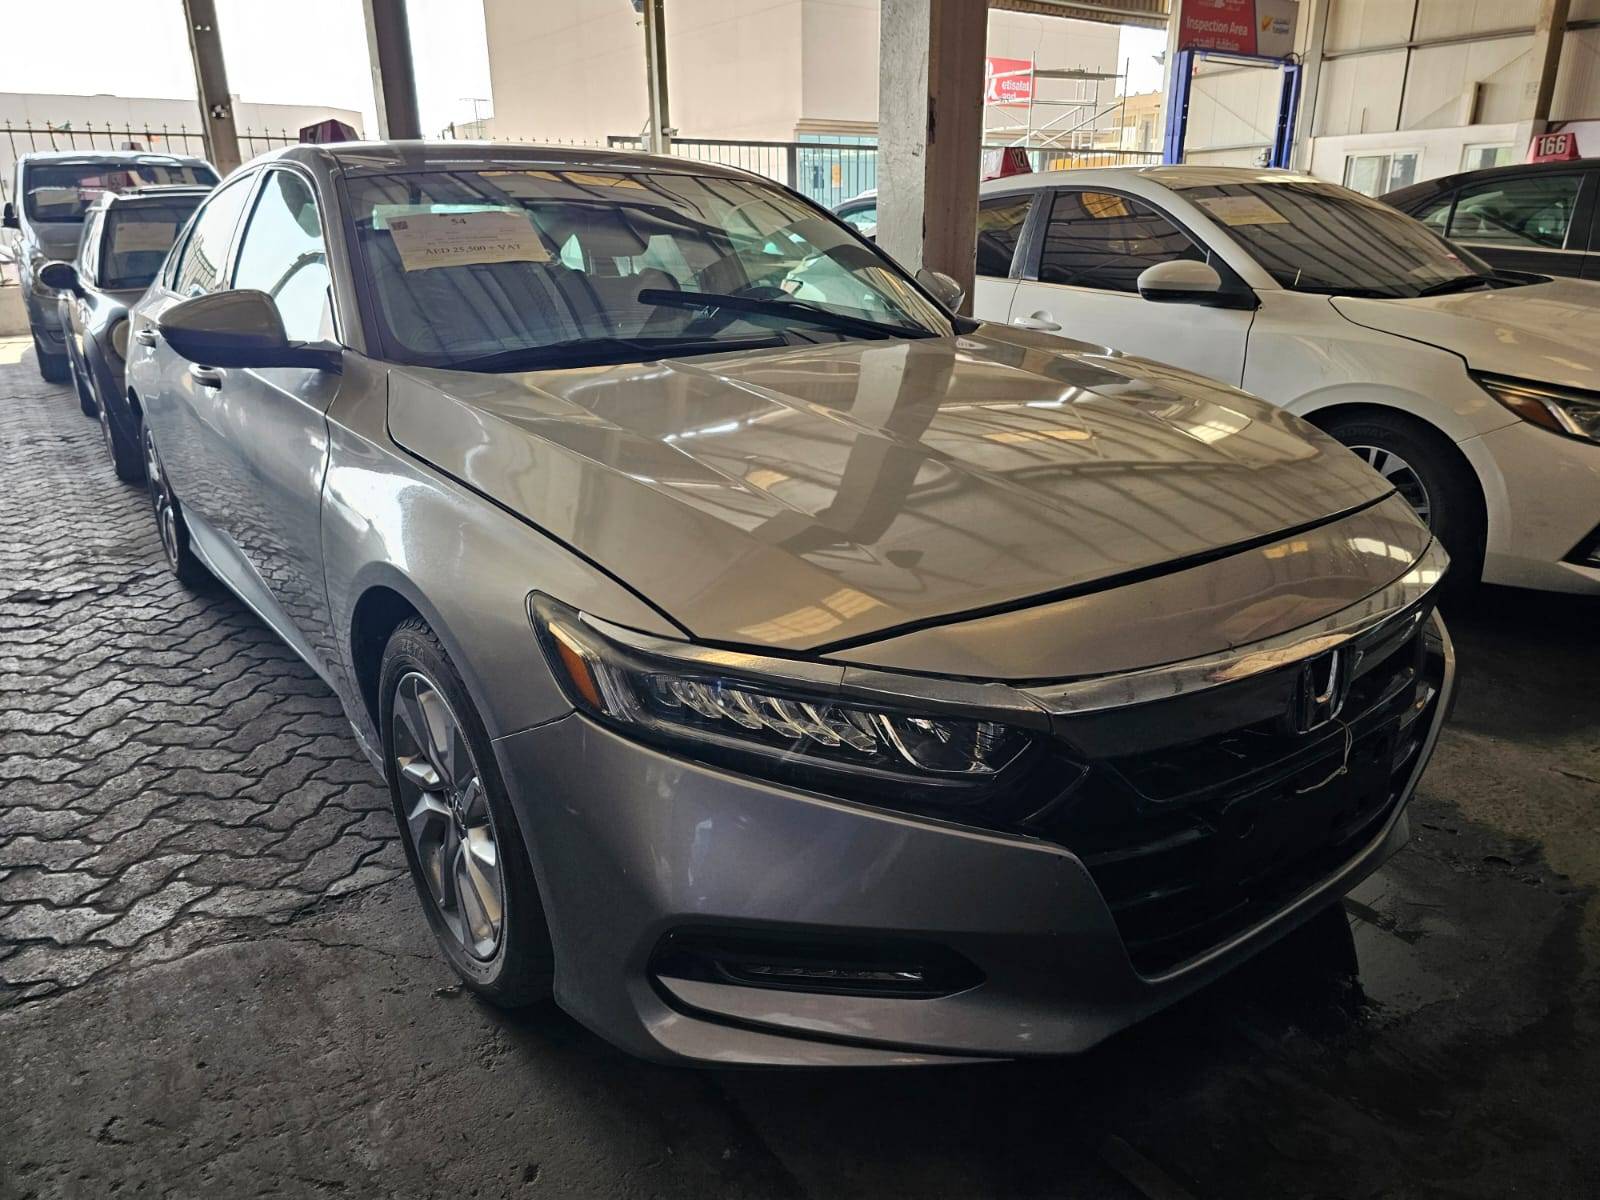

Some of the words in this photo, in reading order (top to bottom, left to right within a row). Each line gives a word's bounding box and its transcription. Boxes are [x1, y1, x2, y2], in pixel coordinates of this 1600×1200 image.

[1186, 16, 1229, 34] Inspection
[1230, 21, 1248, 36] Area
[1539, 135, 1566, 156] 166
[498, 243, 521, 251] VAT
